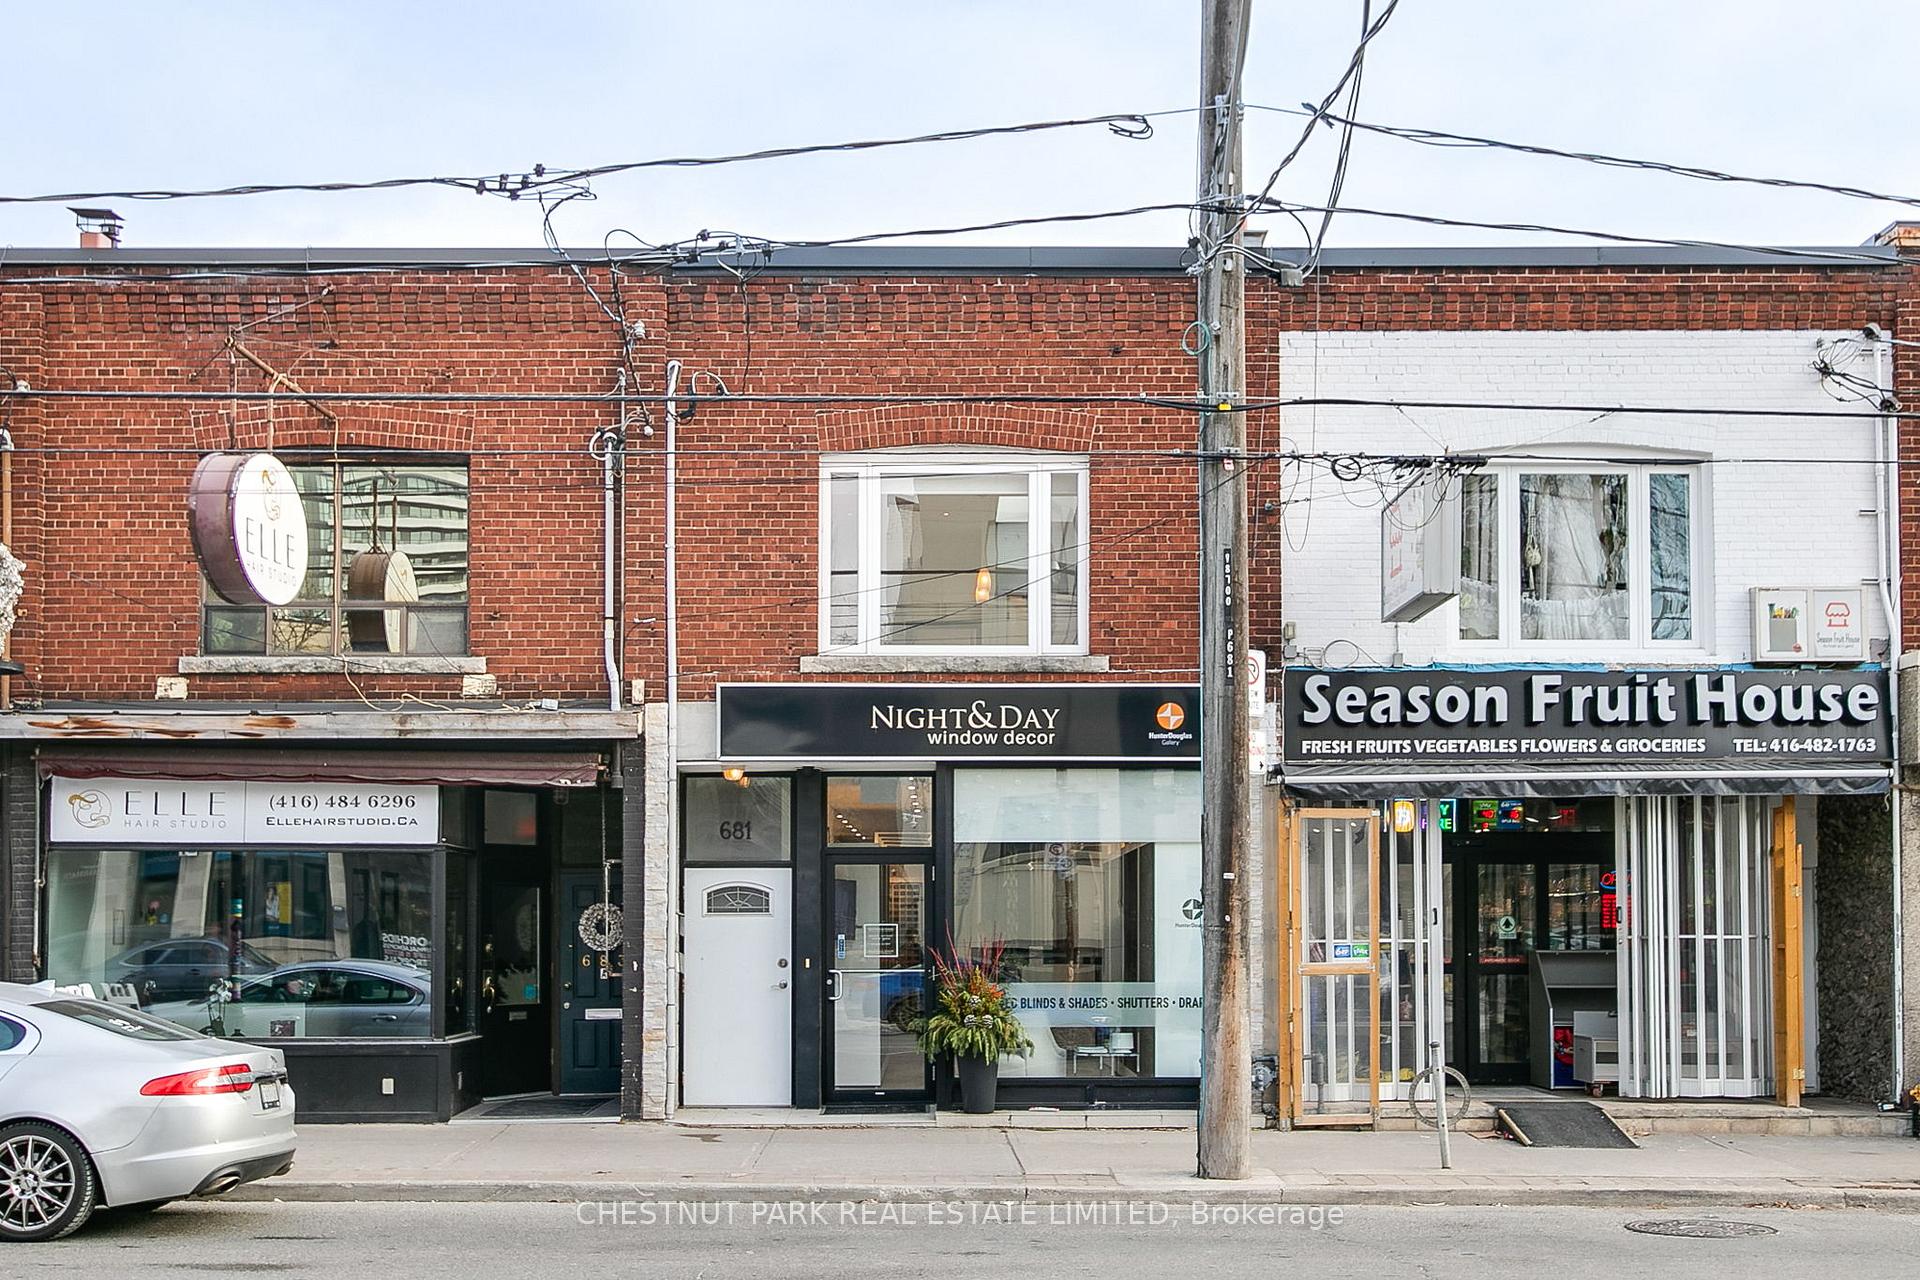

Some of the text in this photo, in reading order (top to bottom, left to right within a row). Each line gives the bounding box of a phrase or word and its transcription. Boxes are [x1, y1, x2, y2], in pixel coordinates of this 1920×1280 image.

[246, 517, 295, 569] ELLE
[1226, 628, 1234, 678] P681
[1303, 674, 1508, 723] Season
[1531, 674, 1676, 723] Fruit
[1695, 673, 1880, 722] House
[927, 730, 1055, 745] window decor
[1302, 738, 1877, 754] FRESH FRUITS VEGETABLES FLOWERS & GROCERIES TEL: 416-482-1763
[124, 790, 416, 816] ELLE (416) 484 6296
[123, 819, 160, 828] HAIR
[170, 819, 227, 829] STUDIO
[720, 821, 751, 840] 681
[1020, 997, 1056, 1008] BLINDS
[1059, 997, 1065, 1008] &
[1068, 997, 1108, 1008] SHADES
[1117, 997, 1169, 1008] SHUTTERS
